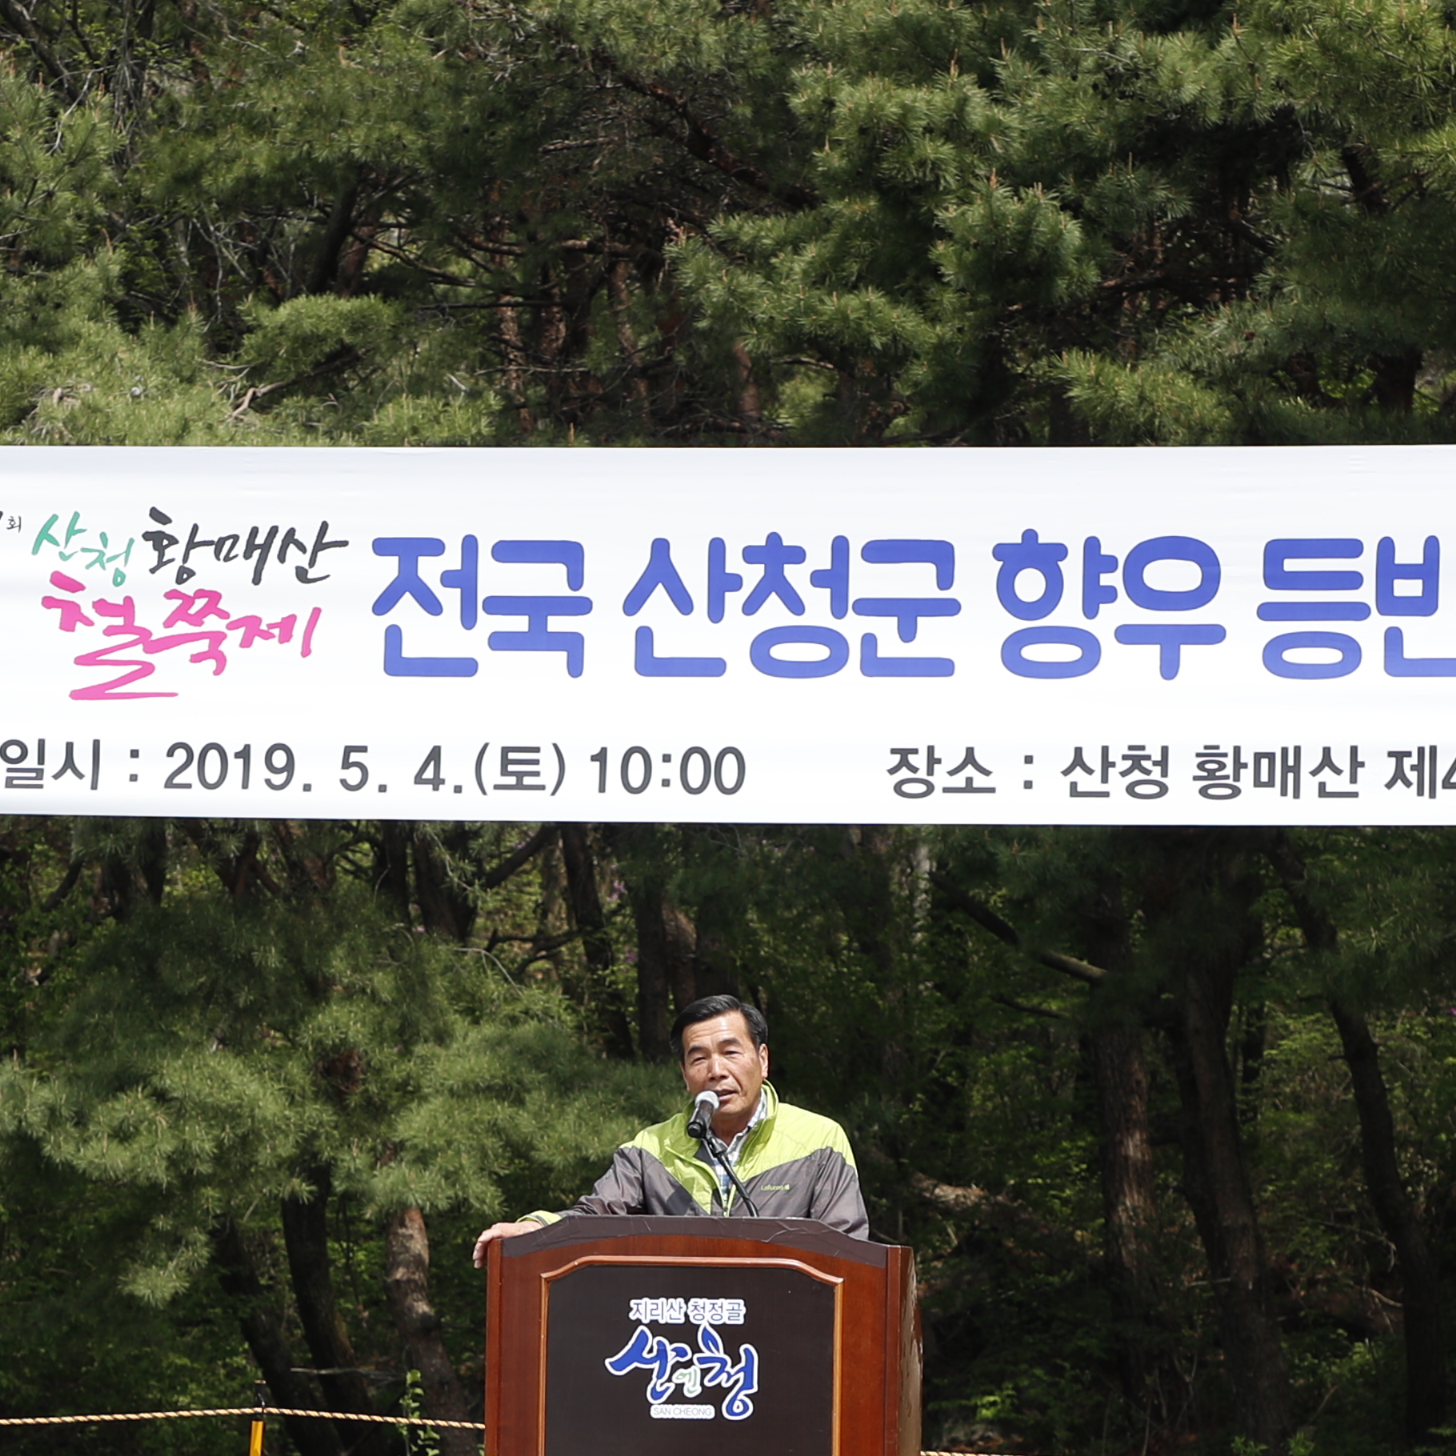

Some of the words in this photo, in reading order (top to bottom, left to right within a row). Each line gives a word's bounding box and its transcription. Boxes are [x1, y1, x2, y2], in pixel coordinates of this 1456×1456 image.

[31, 511, 136, 588] 산청
[140, 505, 350, 586] 황매산
[371, 532, 594, 679] 전국
[622, 530, 963, 679] 산청군
[992, 527, 1227, 680] 향우
[40, 569, 323, 701] 철쭉제
[163, 741, 312, 792] 2019.
[338, 744, 387, 793] 5.
[589, 744, 747, 796] 10:00
[885, 744, 997, 799] 장소
[1059, 743, 1170, 800] 산청
[1191, 744, 1366, 800] 황매산
[631, 1299, 686, 1323] 지리산
[689, 1299, 746, 1324] 청정골
[652, 1405, 672, 1418] SAN
[673, 1405, 713, 1418] CHEONG
